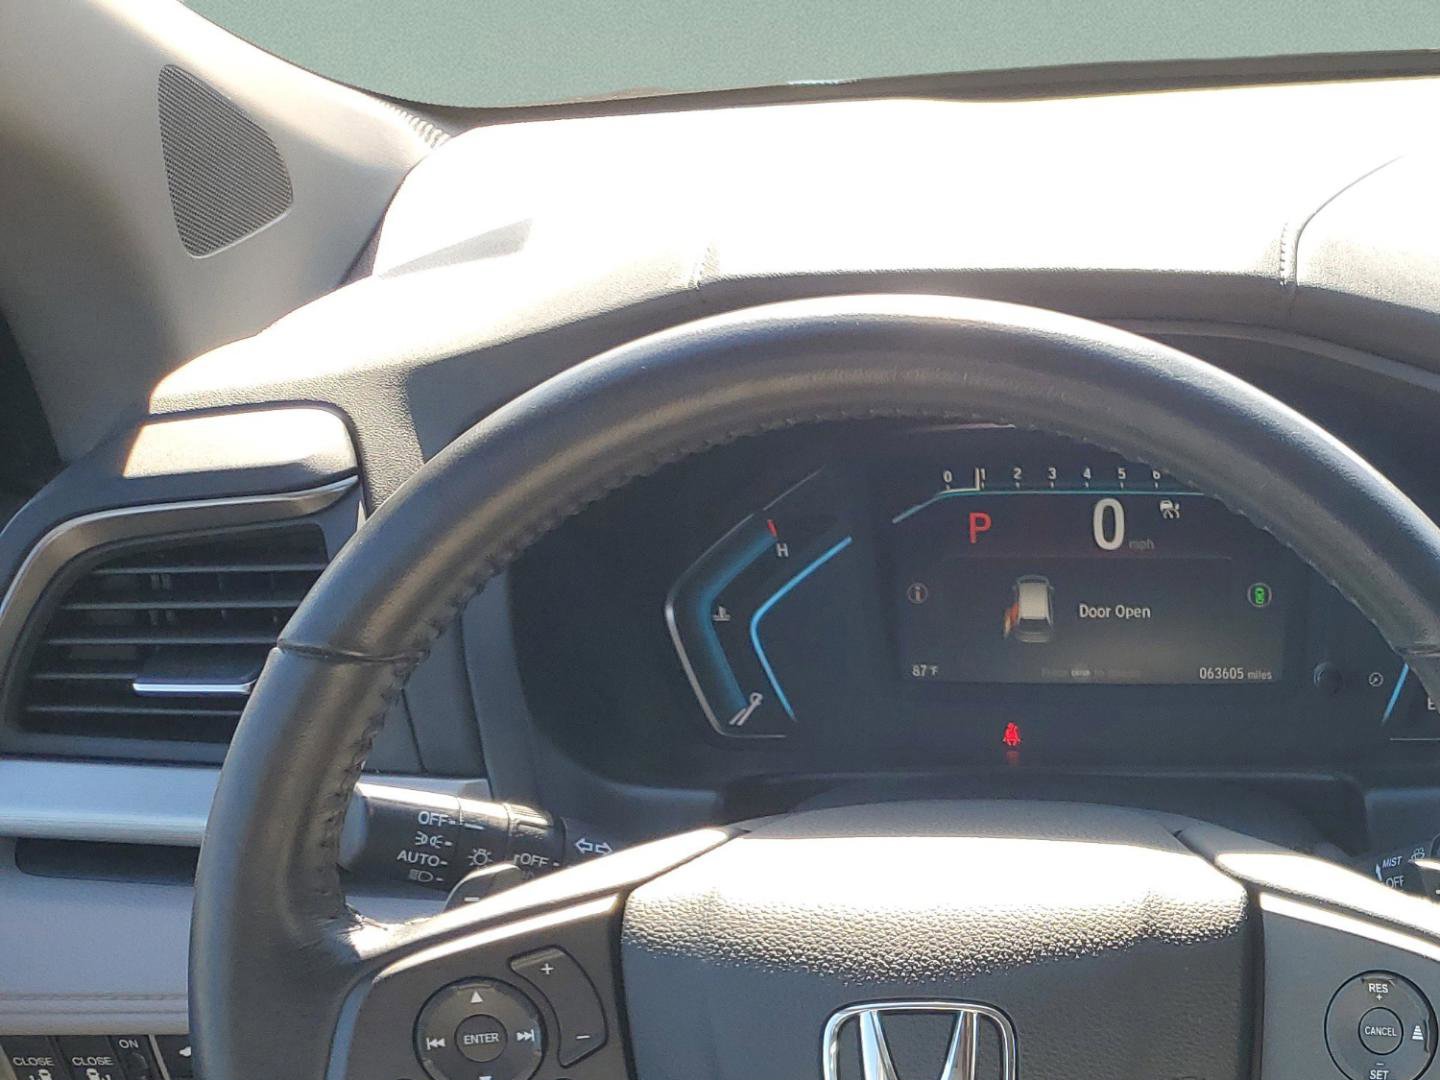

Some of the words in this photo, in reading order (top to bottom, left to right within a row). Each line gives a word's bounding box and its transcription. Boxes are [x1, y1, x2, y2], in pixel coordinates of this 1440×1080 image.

[1013, 467, 1023, 480] 2
[1048, 467, 1058, 480] 3
[1083, 467, 1092, 480] 4
[1118, 467, 1127, 480] 5
[968, 512, 993, 544] P
[1093, 498, 1125, 551] 0
[776, 543, 790, 558] H
[1079, 604, 1112, 619] Door
[1115, 604, 1152, 621] Open
[1199, 667, 1245, 680] 063605
[1247, 671, 1273, 680] miles
[418, 811, 448, 827] OFF
[397, 850, 441, 867] AUTO
[1382, 855, 1404, 869] MIST
[1368, 983, 1389, 994] RES
[463, 1032, 500, 1045] ENTER
[1364, 1026, 1398, 1038] CANCEL
[119, 1039, 139, 1049] ON
[12, 1056, 55, 1067] CLOSE
[72, 1056, 115, 1066] CLOSE
[1369, 1069, 1390, 1080] SET
